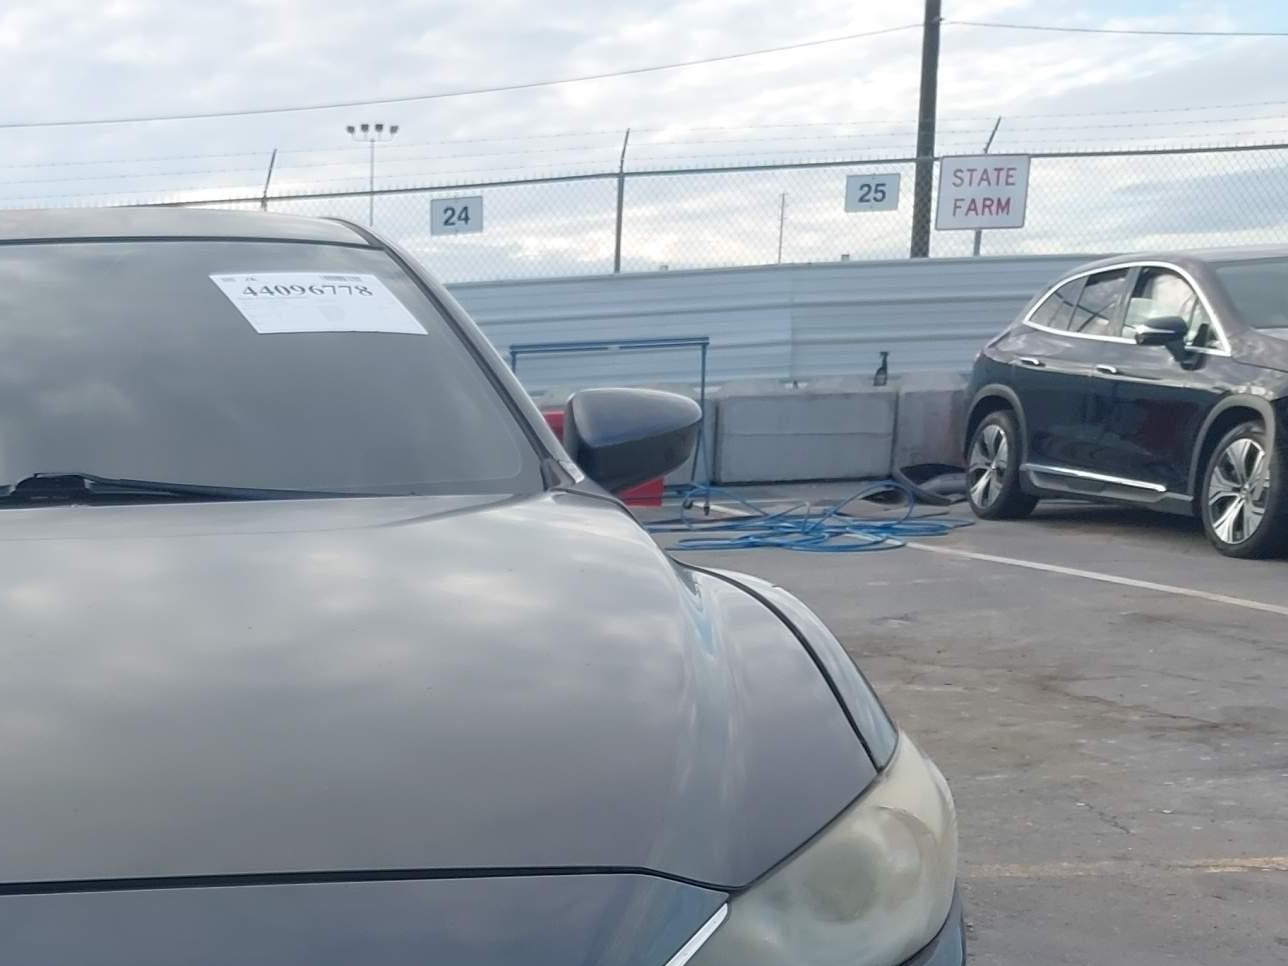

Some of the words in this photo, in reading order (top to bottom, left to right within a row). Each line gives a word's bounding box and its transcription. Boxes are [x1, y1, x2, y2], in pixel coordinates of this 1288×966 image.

[952, 167, 1017, 187] STATE
[857, 183, 887, 203] 25
[443, 206, 471, 226] 24
[952, 197, 1012, 217] FARM
[242, 284, 374, 297] 44096778
